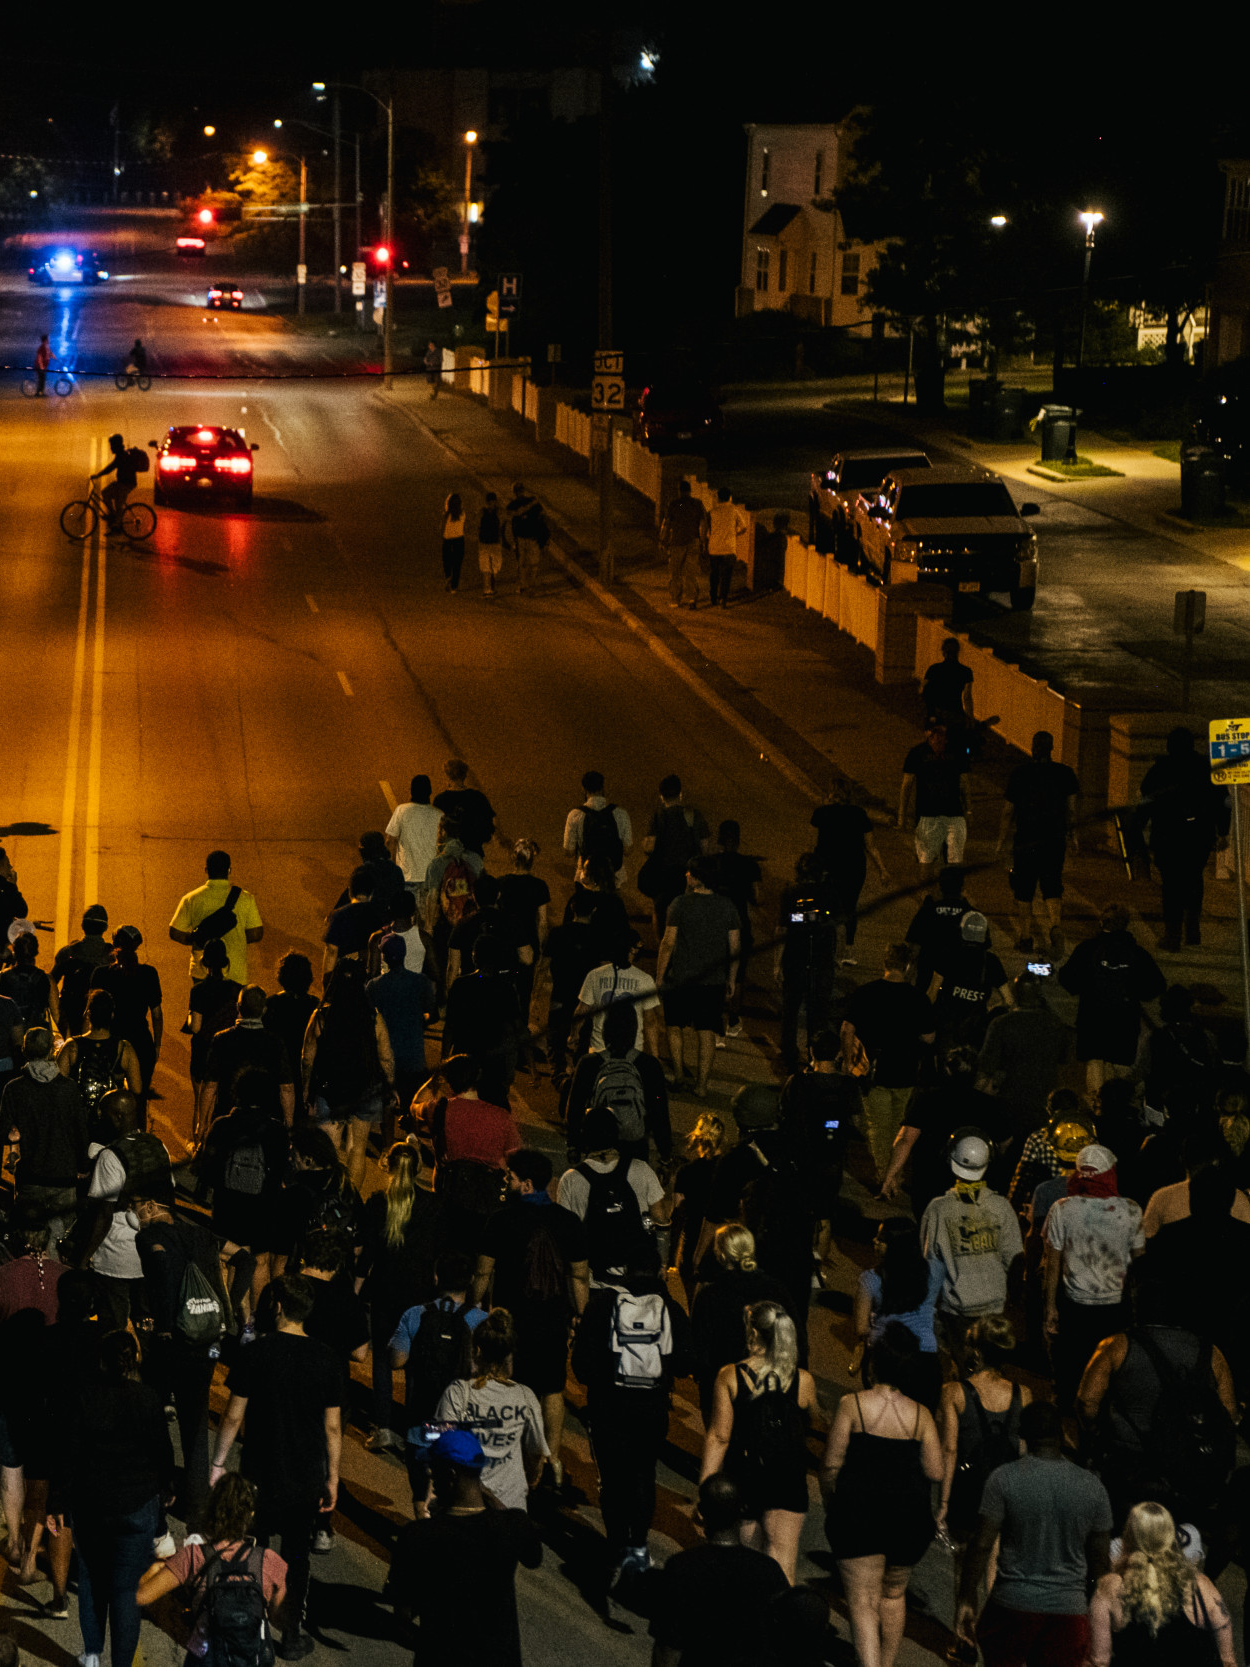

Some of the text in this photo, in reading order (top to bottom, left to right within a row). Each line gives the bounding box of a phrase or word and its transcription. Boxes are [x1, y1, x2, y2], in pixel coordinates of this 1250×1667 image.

[502, 277, 517, 295] H
[596, 354, 621, 369] JCT
[594, 383, 621, 403] 32
[1215, 732, 1250, 741] BUS STOP
[599, 976, 639, 991] PRIITIVE
[952, 986, 986, 1002] PRESS
